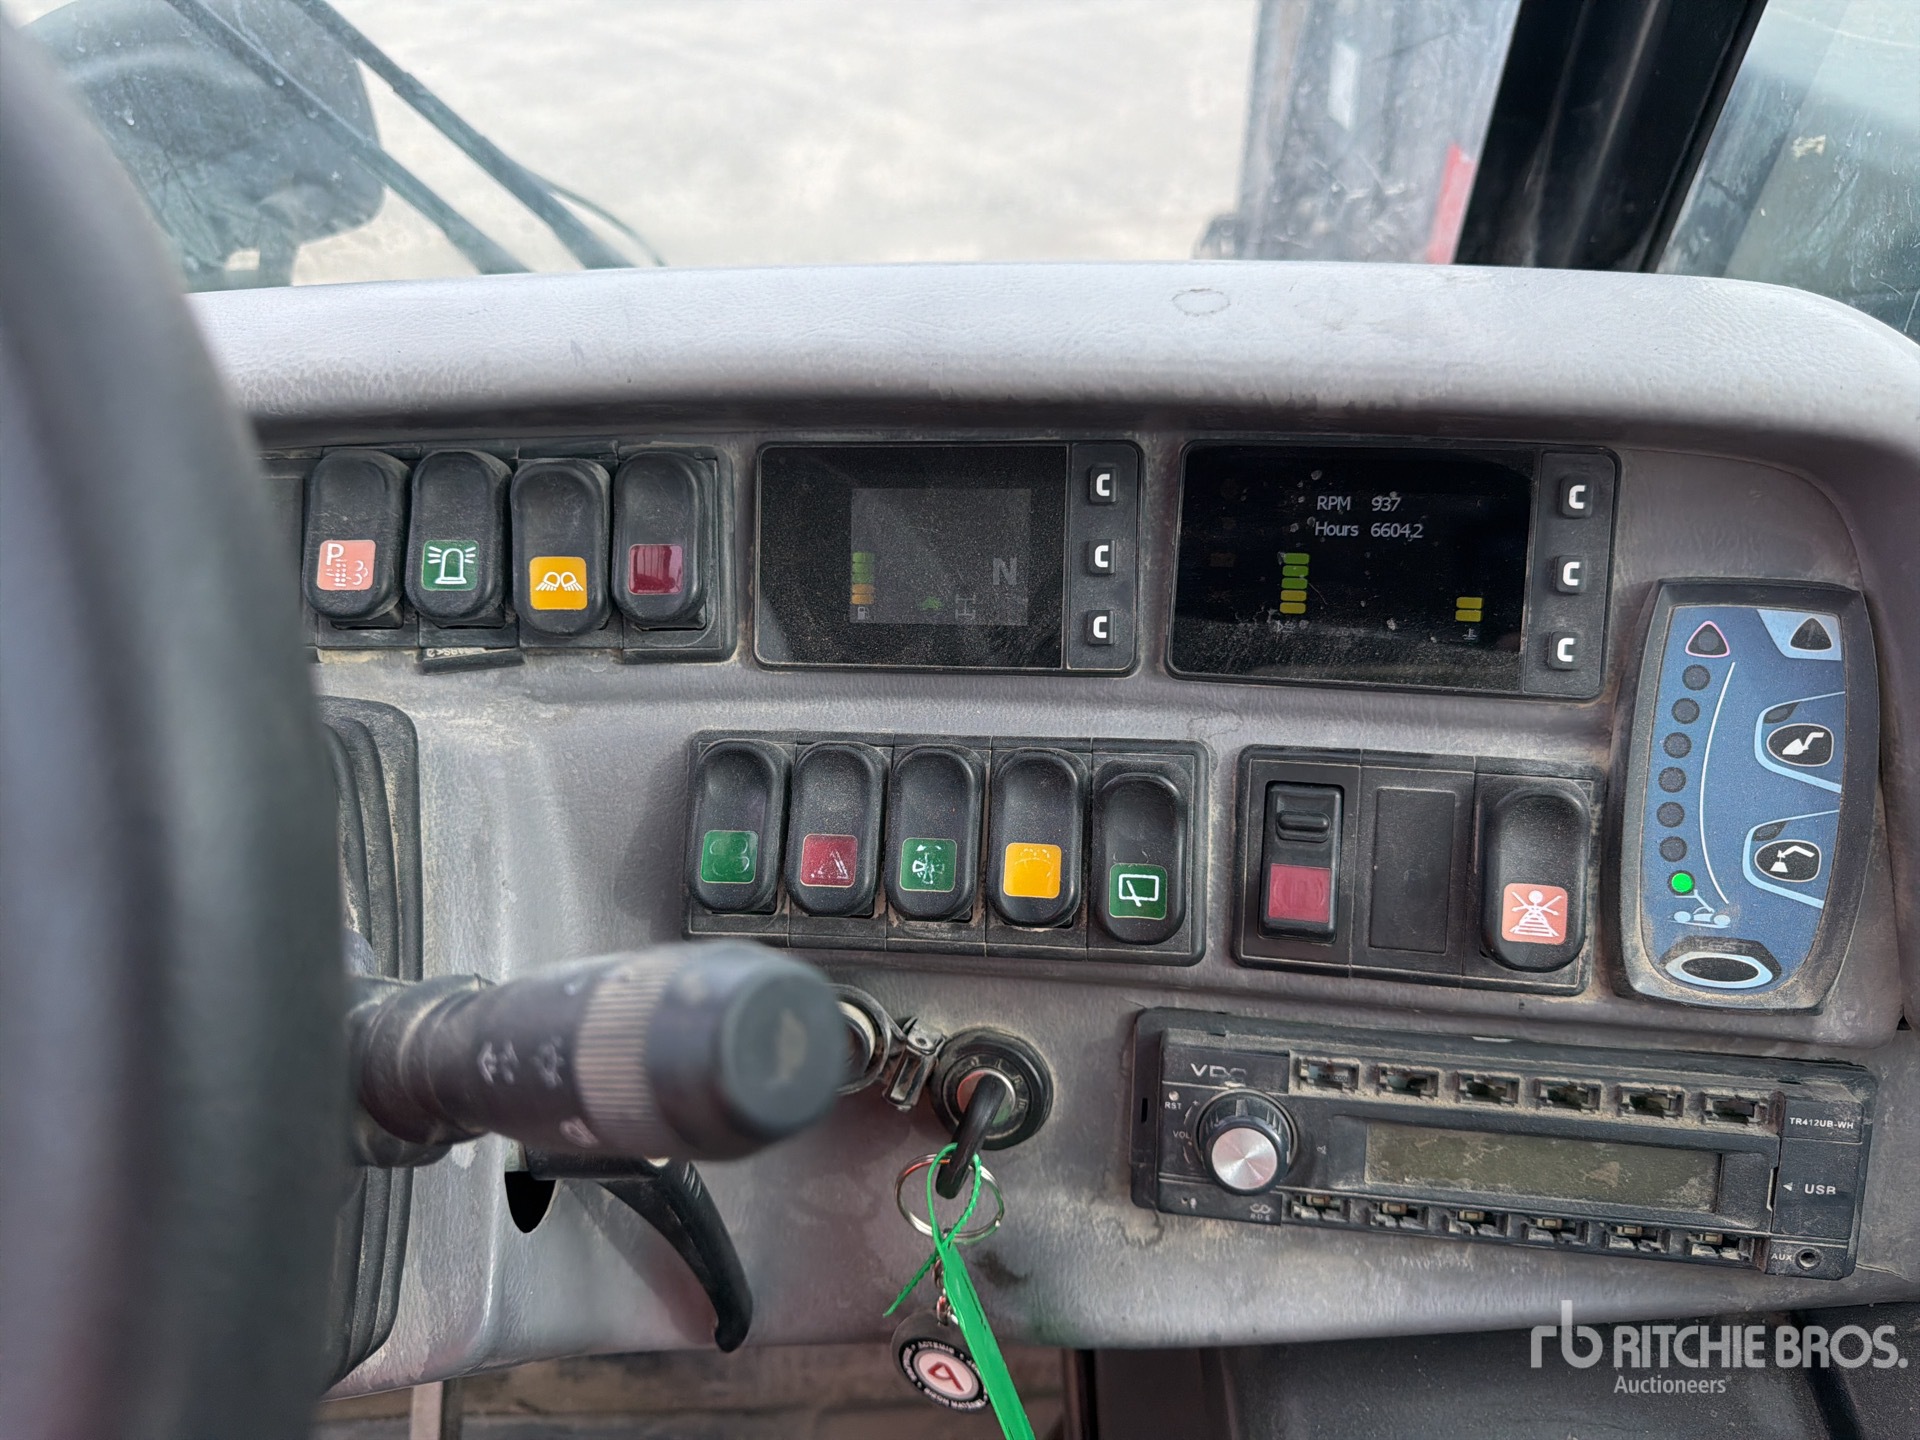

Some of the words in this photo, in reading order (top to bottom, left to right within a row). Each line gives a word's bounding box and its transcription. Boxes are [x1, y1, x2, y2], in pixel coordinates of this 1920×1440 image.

[1316, 495, 1352, 511] RPM
[1371, 496, 1402, 512] 937
[1314, 521, 1360, 537] Hours
[326, 543, 345, 566] P
[992, 557, 1017, 586] N
[1164, 1101, 1182, 1111] RST
[1789, 1116, 1855, 1130] TR412UB-WH
[1172, 1130, 1190, 1140] VOL
[1804, 1183, 1837, 1196] USB
[1770, 1252, 1793, 1262] AUX
